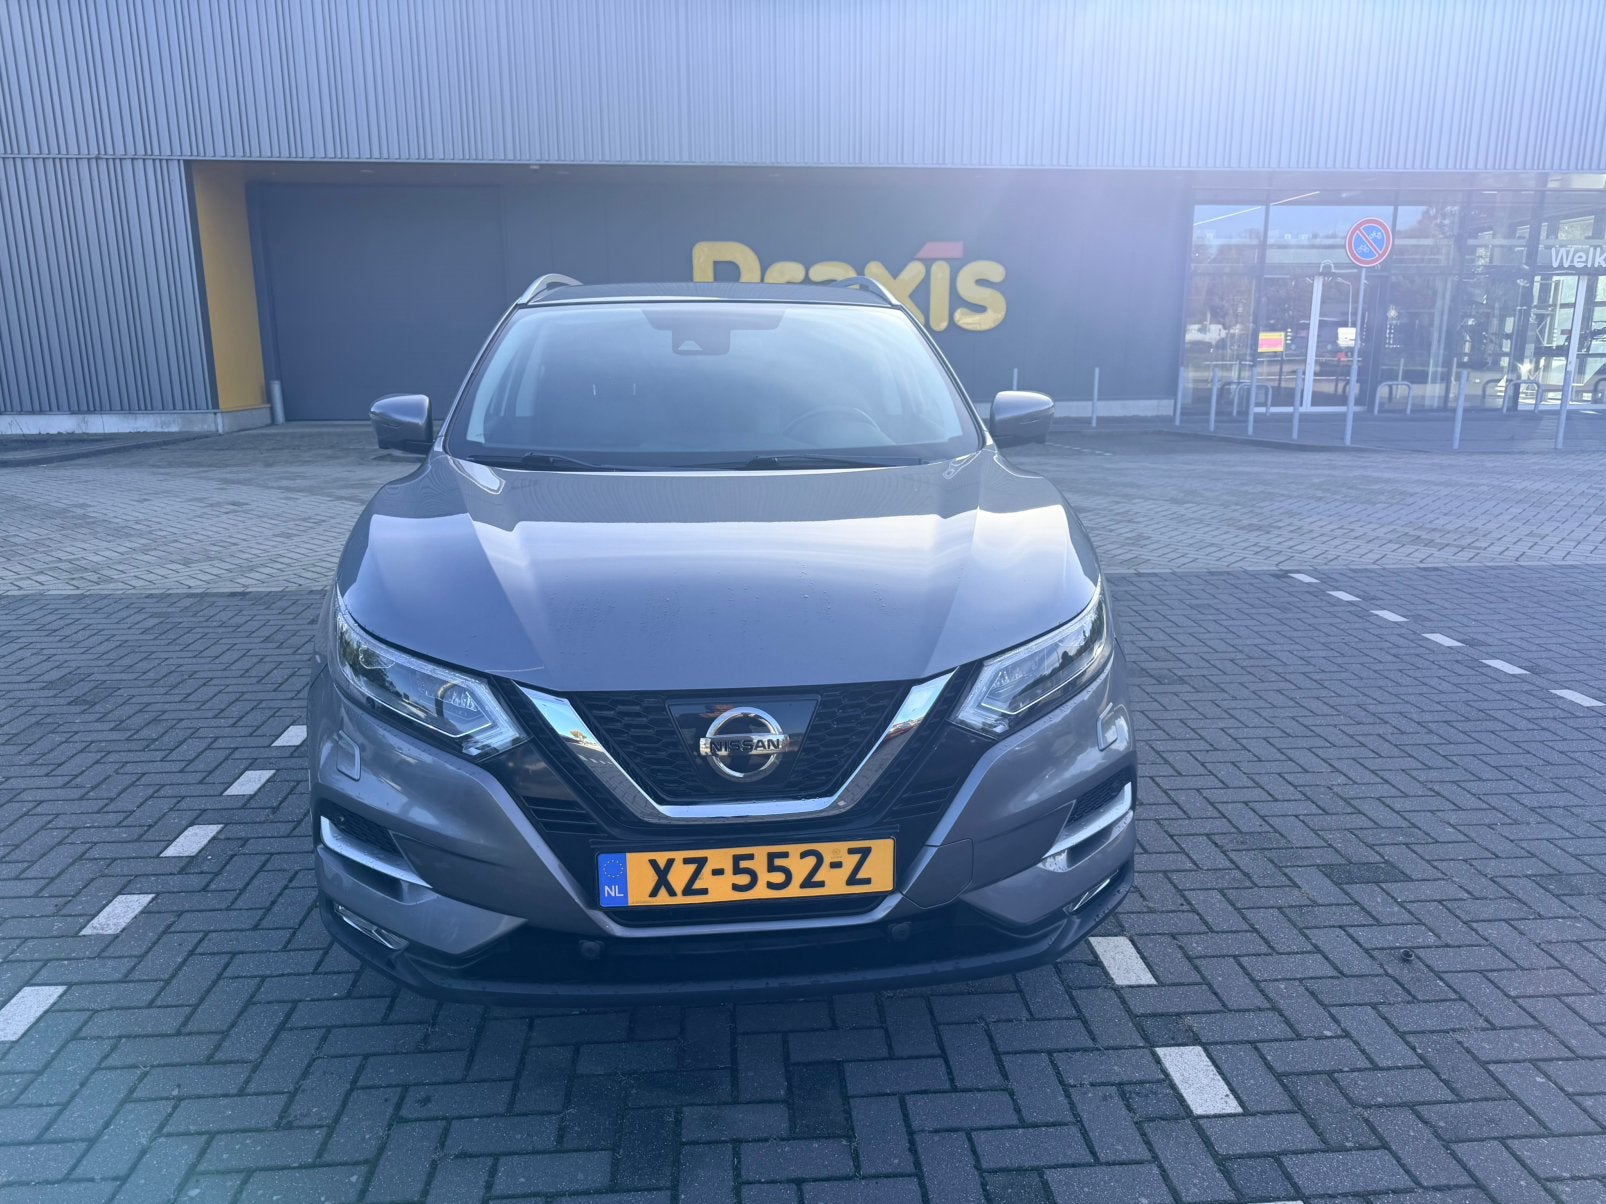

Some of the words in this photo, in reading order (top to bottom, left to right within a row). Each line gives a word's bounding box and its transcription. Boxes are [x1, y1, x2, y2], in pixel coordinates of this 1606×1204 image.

[709, 738, 780, 753] NISSAN
[648, 846, 873, 898] XZ-552-Z
[604, 885, 624, 897] NL
